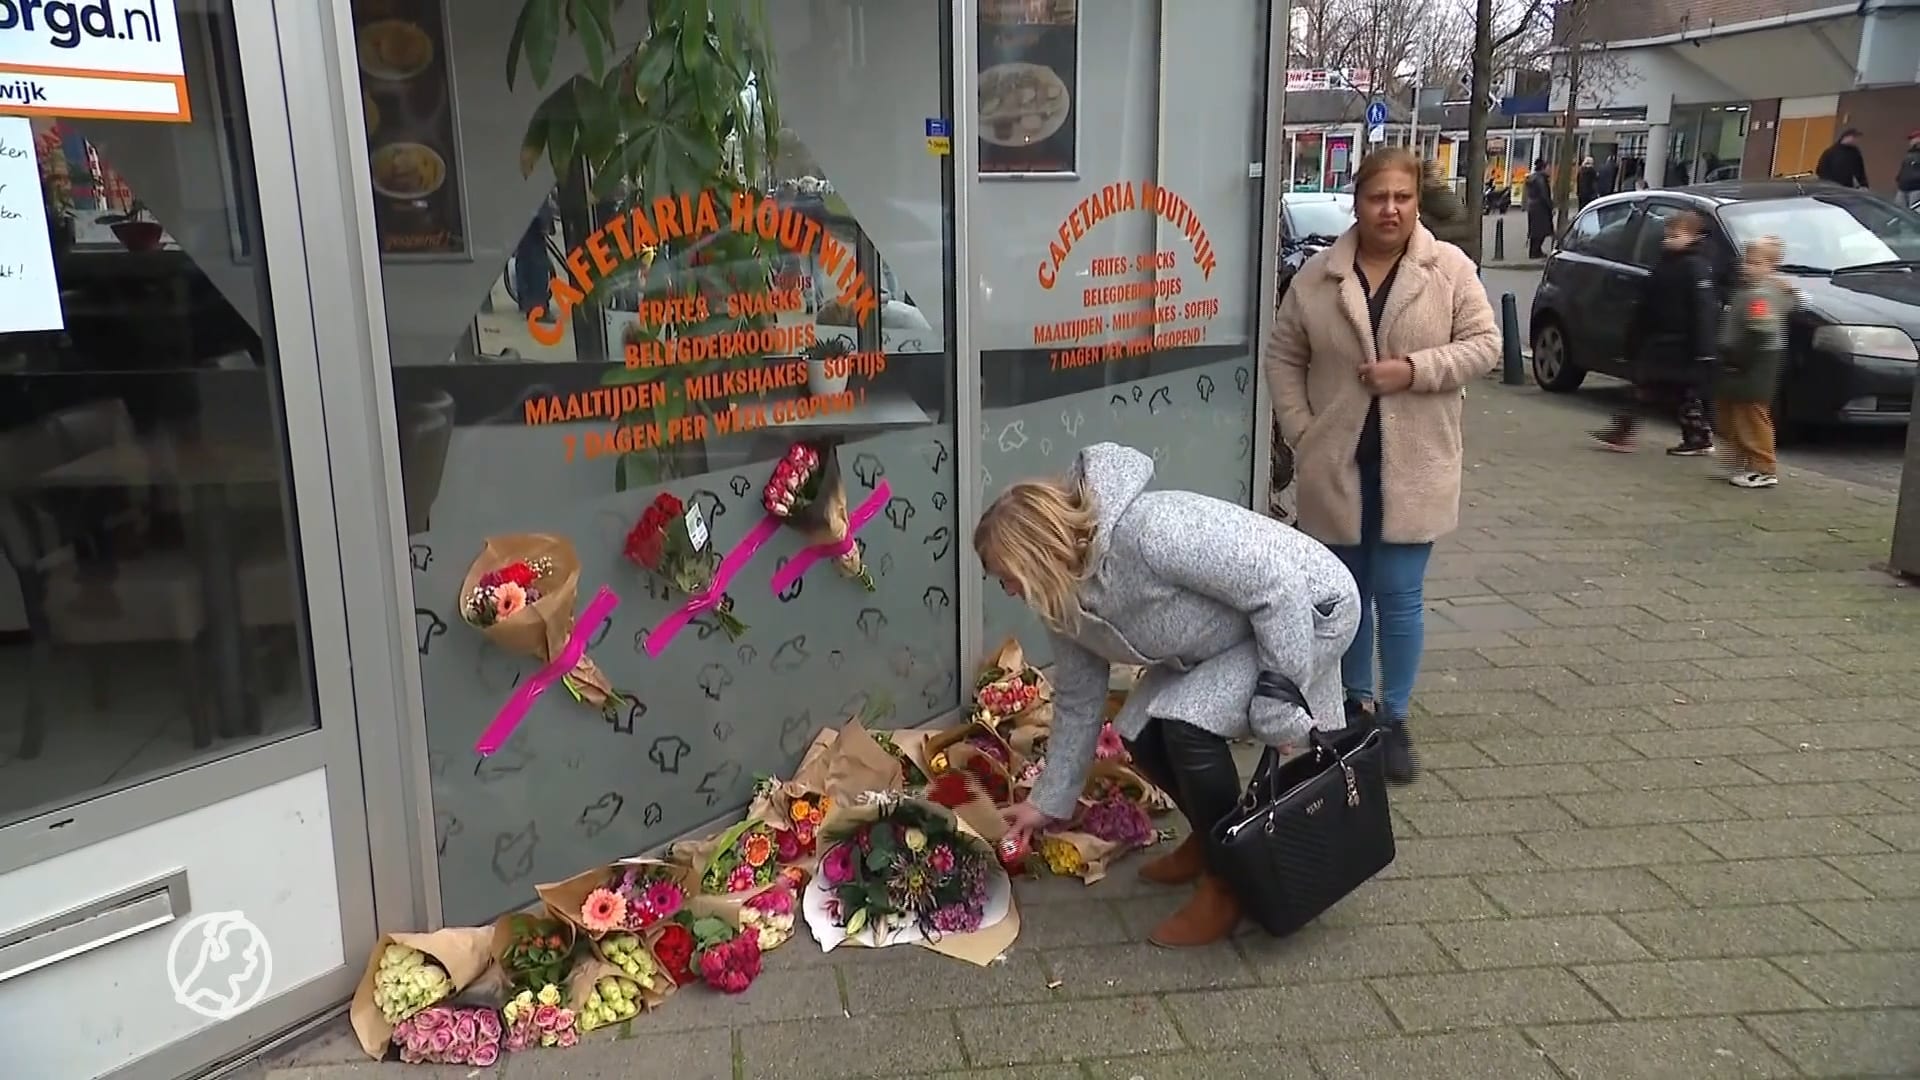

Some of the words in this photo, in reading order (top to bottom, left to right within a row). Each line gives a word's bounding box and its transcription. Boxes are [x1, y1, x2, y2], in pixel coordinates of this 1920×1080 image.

[1038, 181, 1135, 290] CAFETARIA
[527, 190, 720, 345] CAFETARIA
[731, 191, 877, 329] HOUTWIJK
[1091, 255, 1128, 278] FRITES
[638, 295, 709, 326] FRITES
[727, 289, 804, 320] SNACKS
[1082, 277, 1182, 308] BELEGDEBODJES
[1033, 316, 1103, 345] MAALTIJDEN
[1112, 305, 1177, 332] MILKAKES
[1184, 298, 1219, 321] SOFTIJS
[625, 322, 817, 370] BELEGDEBROODJES
[1050, 353, 1058, 372] 7
[1060, 344, 1100, 369] DAGEN
[524, 381, 667, 426] MAALTIJDEN
[685, 360, 809, 402] MILKSHAKES
[823, 351, 887, 381] SOFTIJS
[563, 435, 577, 465] 7
[585, 426, 662, 456] DAGEN
[668, 413, 709, 441] PER
[713, 402, 768, 435] WEEK
